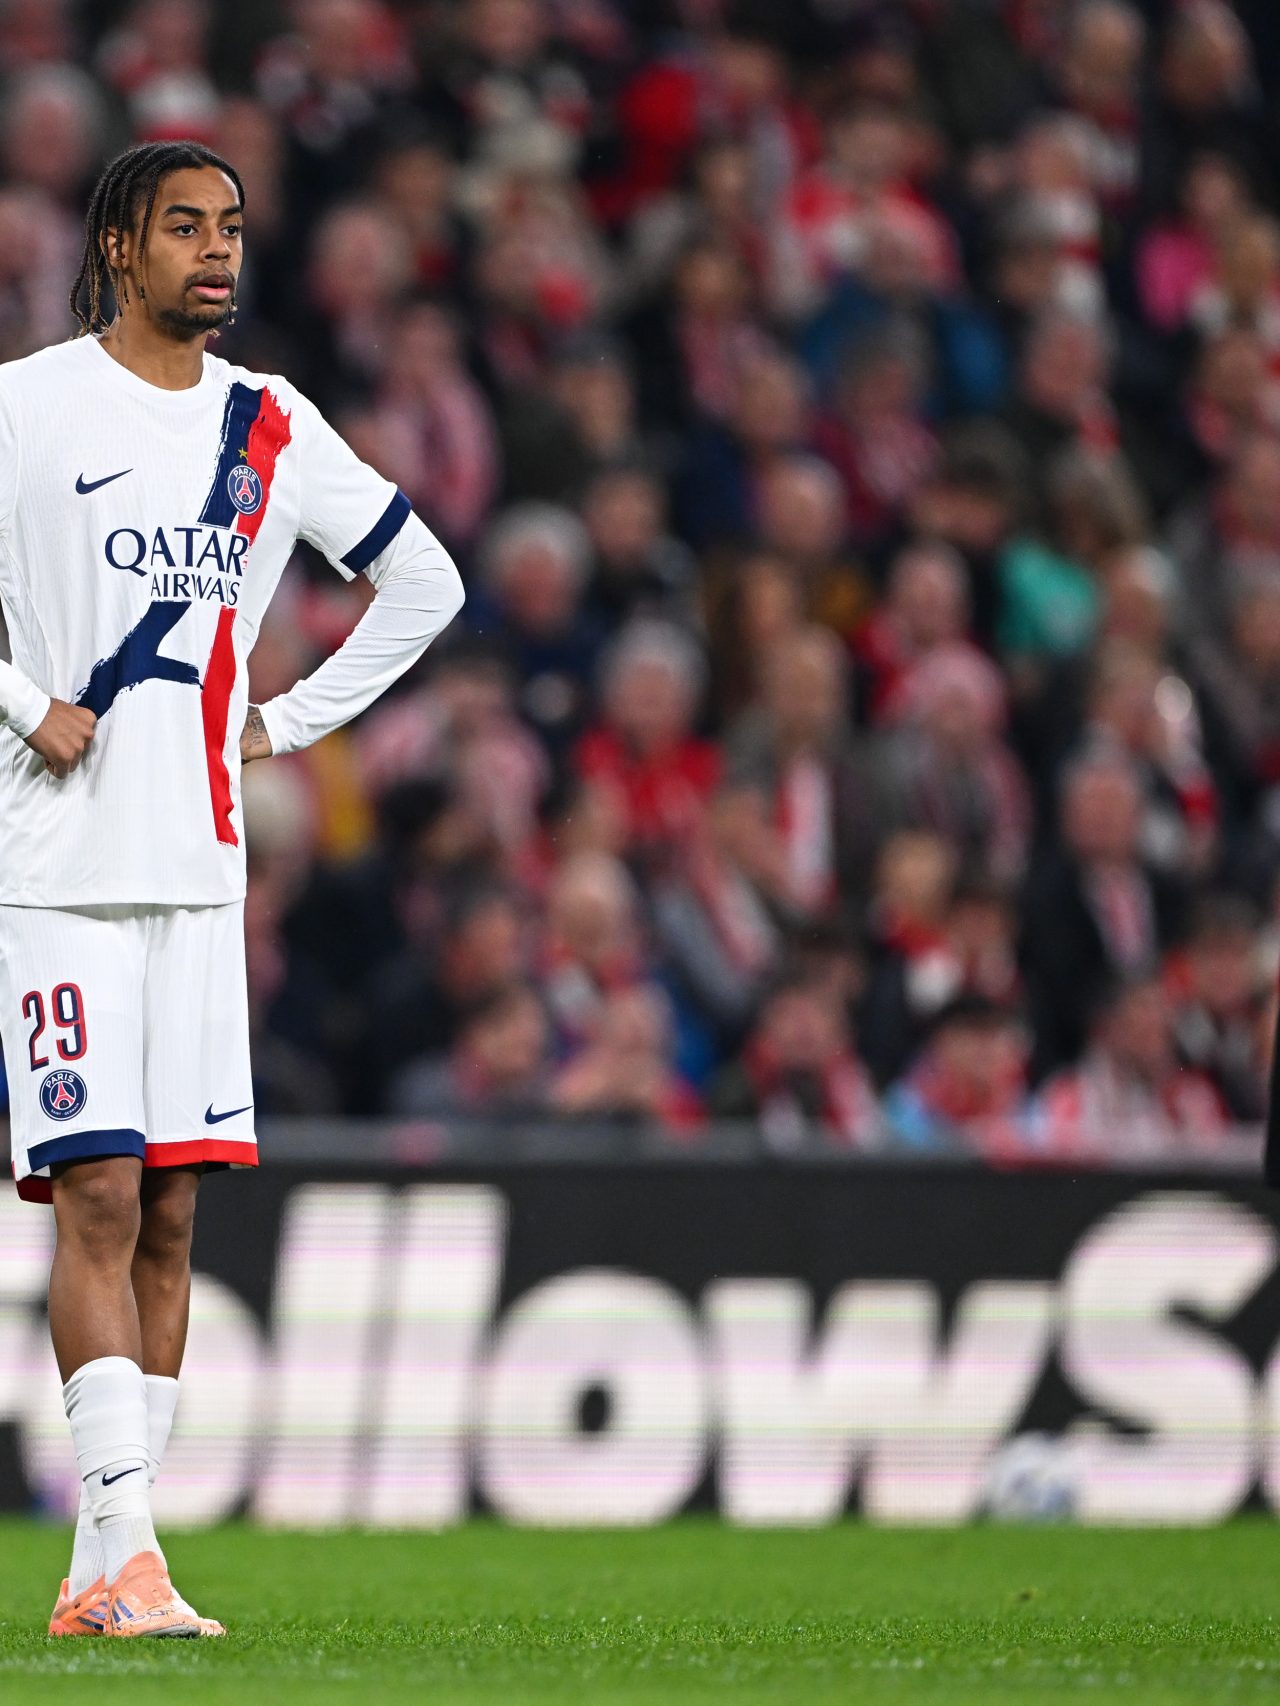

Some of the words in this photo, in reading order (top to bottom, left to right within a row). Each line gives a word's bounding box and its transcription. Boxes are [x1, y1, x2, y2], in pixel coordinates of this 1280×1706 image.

[233, 467, 257, 483] PARIS
[104, 526, 250, 578] QATAR
[151, 572, 241, 605] AIRWAYS
[21, 982, 88, 1072] 29
[46, 1072, 74, 1089] PARIS
